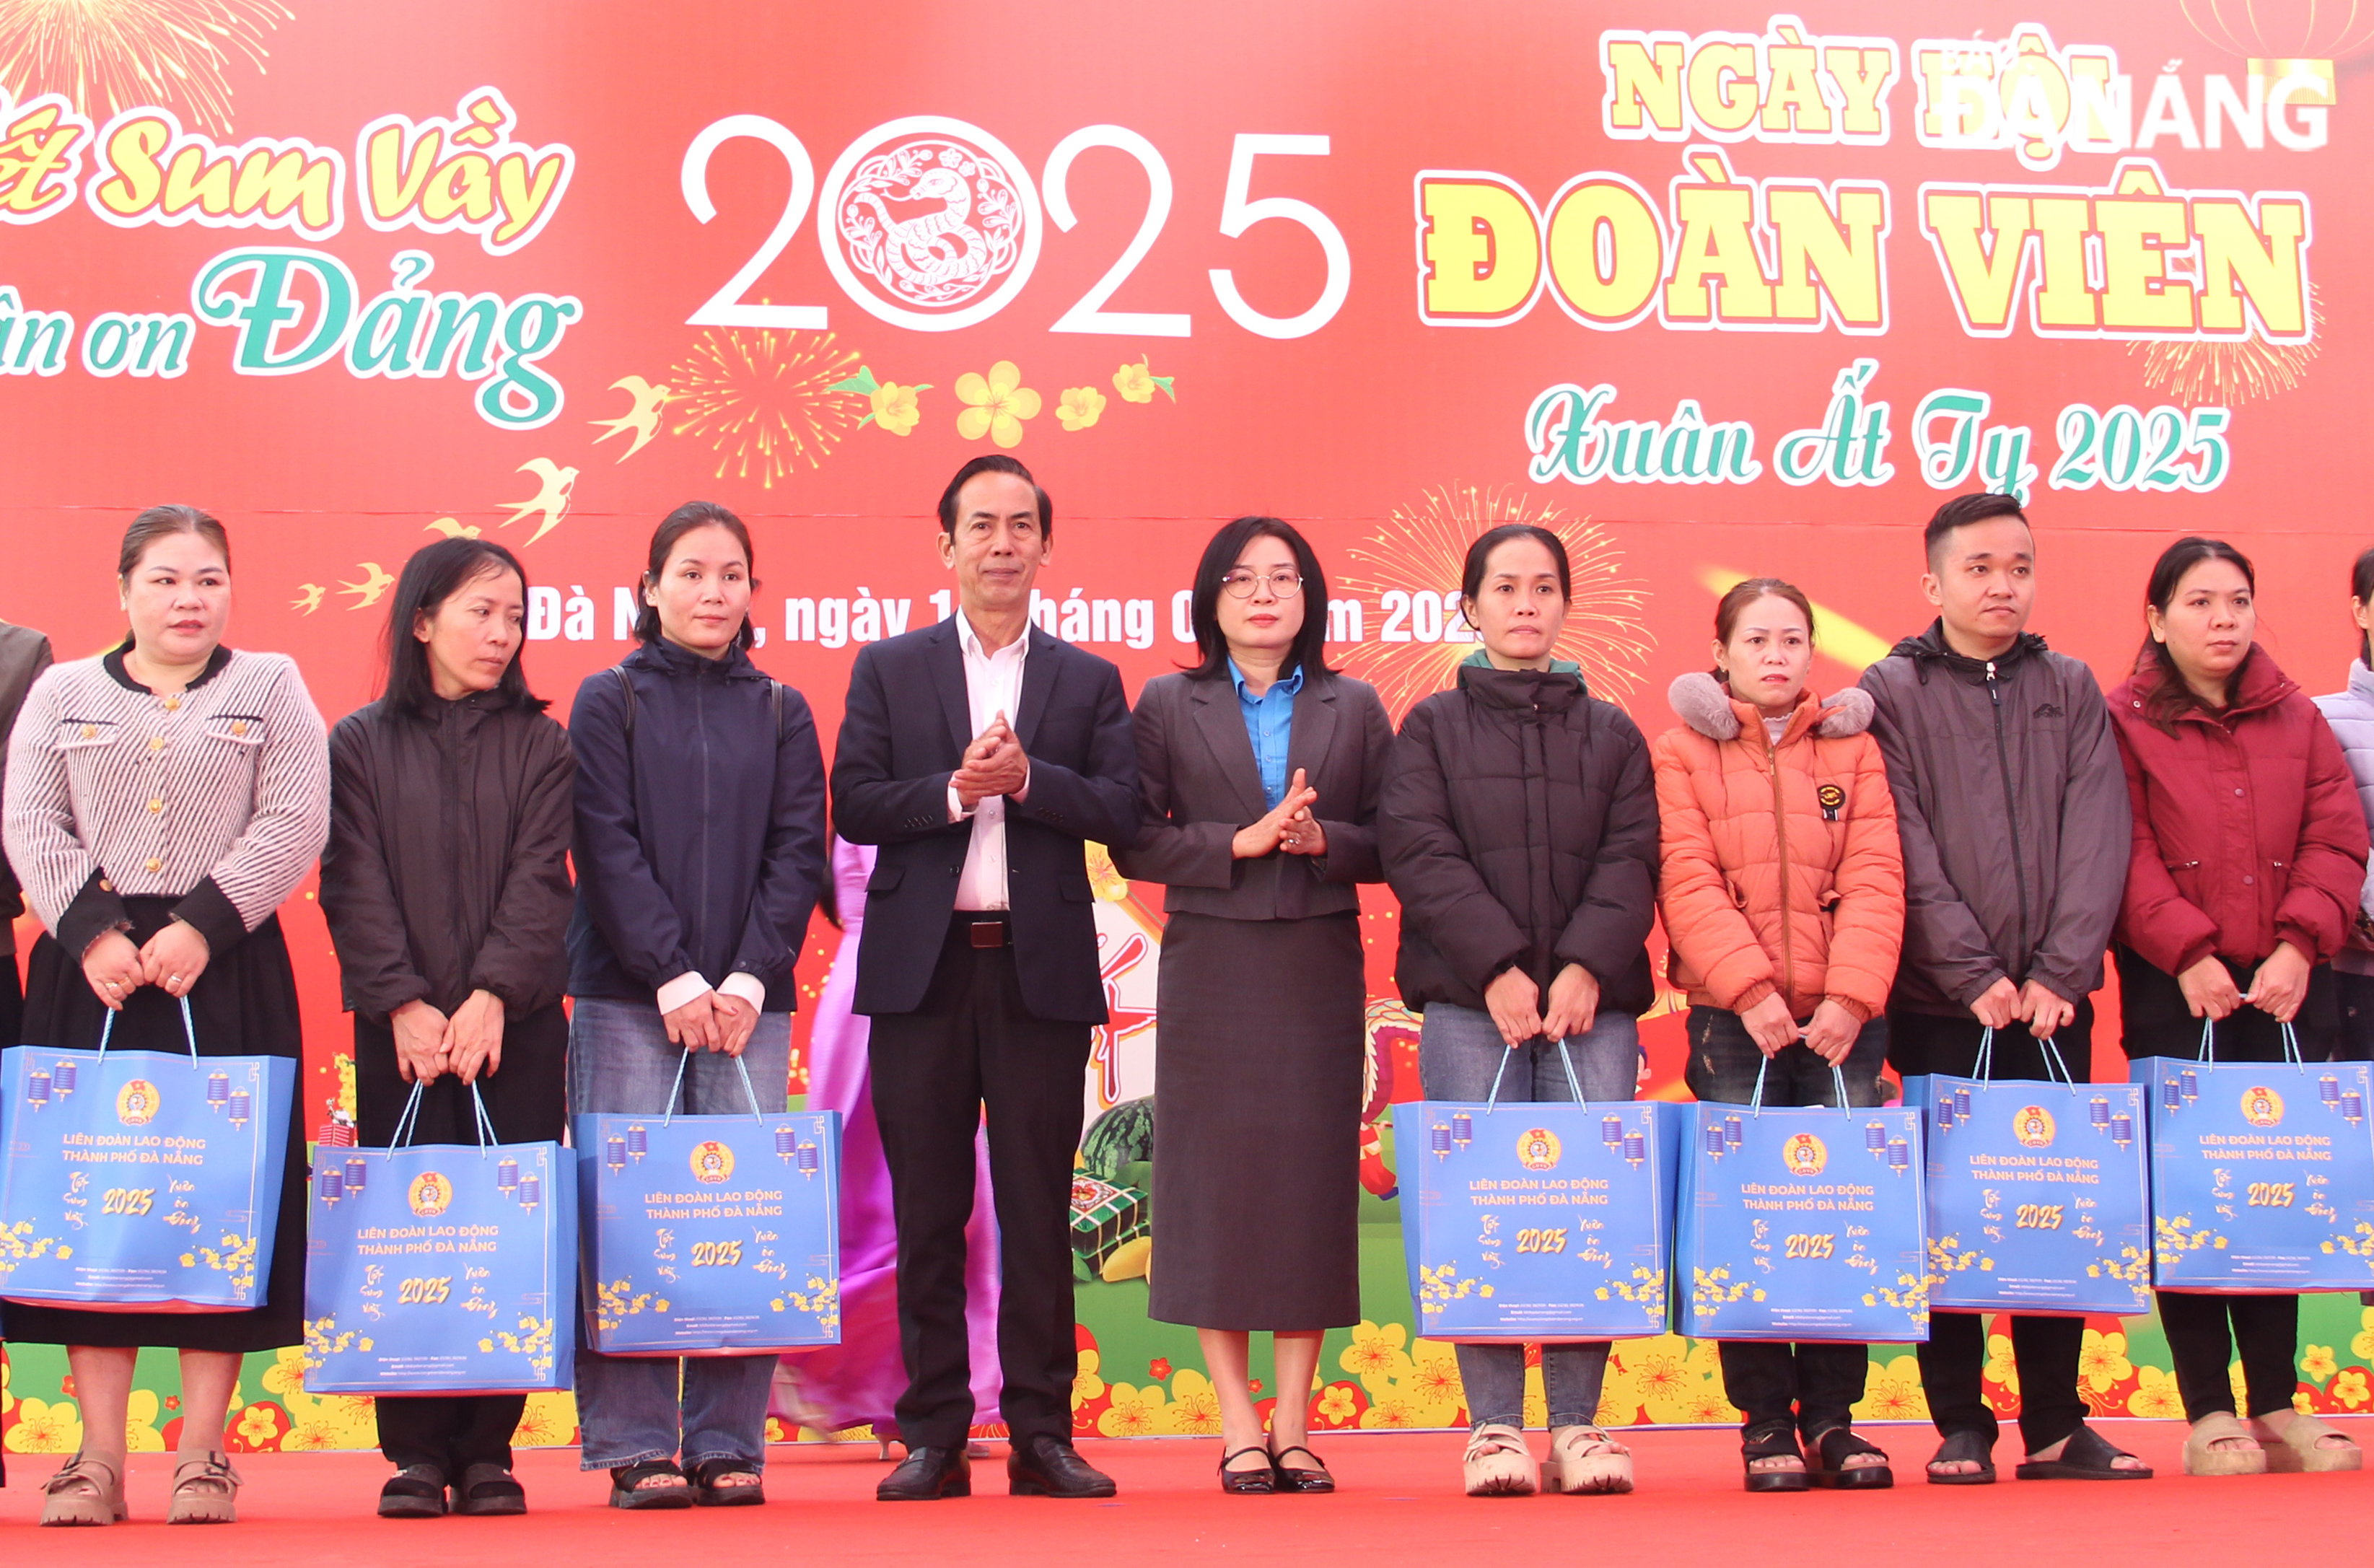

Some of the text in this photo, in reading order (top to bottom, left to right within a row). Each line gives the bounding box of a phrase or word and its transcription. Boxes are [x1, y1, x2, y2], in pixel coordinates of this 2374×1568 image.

[1603, 19, 1896, 139] NGÀY
[94, 113, 338, 235] Sum
[362, 92, 568, 249] Vầy
[681, 114, 1351, 339] 2025
[1419, 151, 2307, 338] ĐOÀN VIÊN
[86, 315, 192, 375] ơn
[195, 250, 579, 426] Đảng
[1528, 362, 2226, 507] Xuân Ất Tỵ 2025
[527, 585, 595, 641] Đà
[785, 587, 912, 649] ngày
[1028, 587, 1155, 649] háng
[1380, 590, 1485, 643] 202
[63, 1132, 206, 1151] LIÊN ĐOÀN LAO ĐỘNG
[2199, 1134, 2331, 1147] LIÊN ĐOÀN LAO ĐỘNG
[63, 1149, 203, 1165] THÀNH PHỐ ĐÀ NẴNG
[1969, 1154, 2098, 1169] LIÊN ĐOÀN LAO ĐỘNG
[2202, 1149, 2244, 1160] THÀNH
[2247, 1148, 2273, 1160] PHỐ
[2276, 1149, 2294, 1160] ĐÀ
[1469, 1177, 1608, 1191] LIÊN ĐOÀN LAO ĐỘNG
[1972, 1169, 2099, 1184] THÀNH PHỐ ĐÀ NẴNG
[644, 1189, 782, 1204] LIÊN ĐOÀN LAO ĐỘNG
[1471, 1191, 1608, 1205] THÀNH PHỐ ĐÀ NẴNG
[1741, 1183, 1874, 1197] LIÊN ĐOÀN LAO ĐỘNG
[2247, 1181, 2295, 1207] 2025
[102, 1188, 155, 1216] 2025
[647, 1203, 782, 1219] THÀNH PHỐ ĐÀ NẴNG
[1743, 1196, 1874, 1211] THÀNH PHỐ ĐÀ NẴNG
[2015, 1204, 2064, 1230] 2025
[357, 1225, 499, 1239] LIÊN ĐOÀN LAO ĐỘNG
[1516, 1227, 1568, 1254] 2025
[358, 1236, 496, 1255] THÀNH PHỐ ĐÀ NẴNG
[691, 1240, 743, 1268] 2025
[1784, 1234, 1836, 1259] 2025
[398, 1276, 452, 1305] 2025
